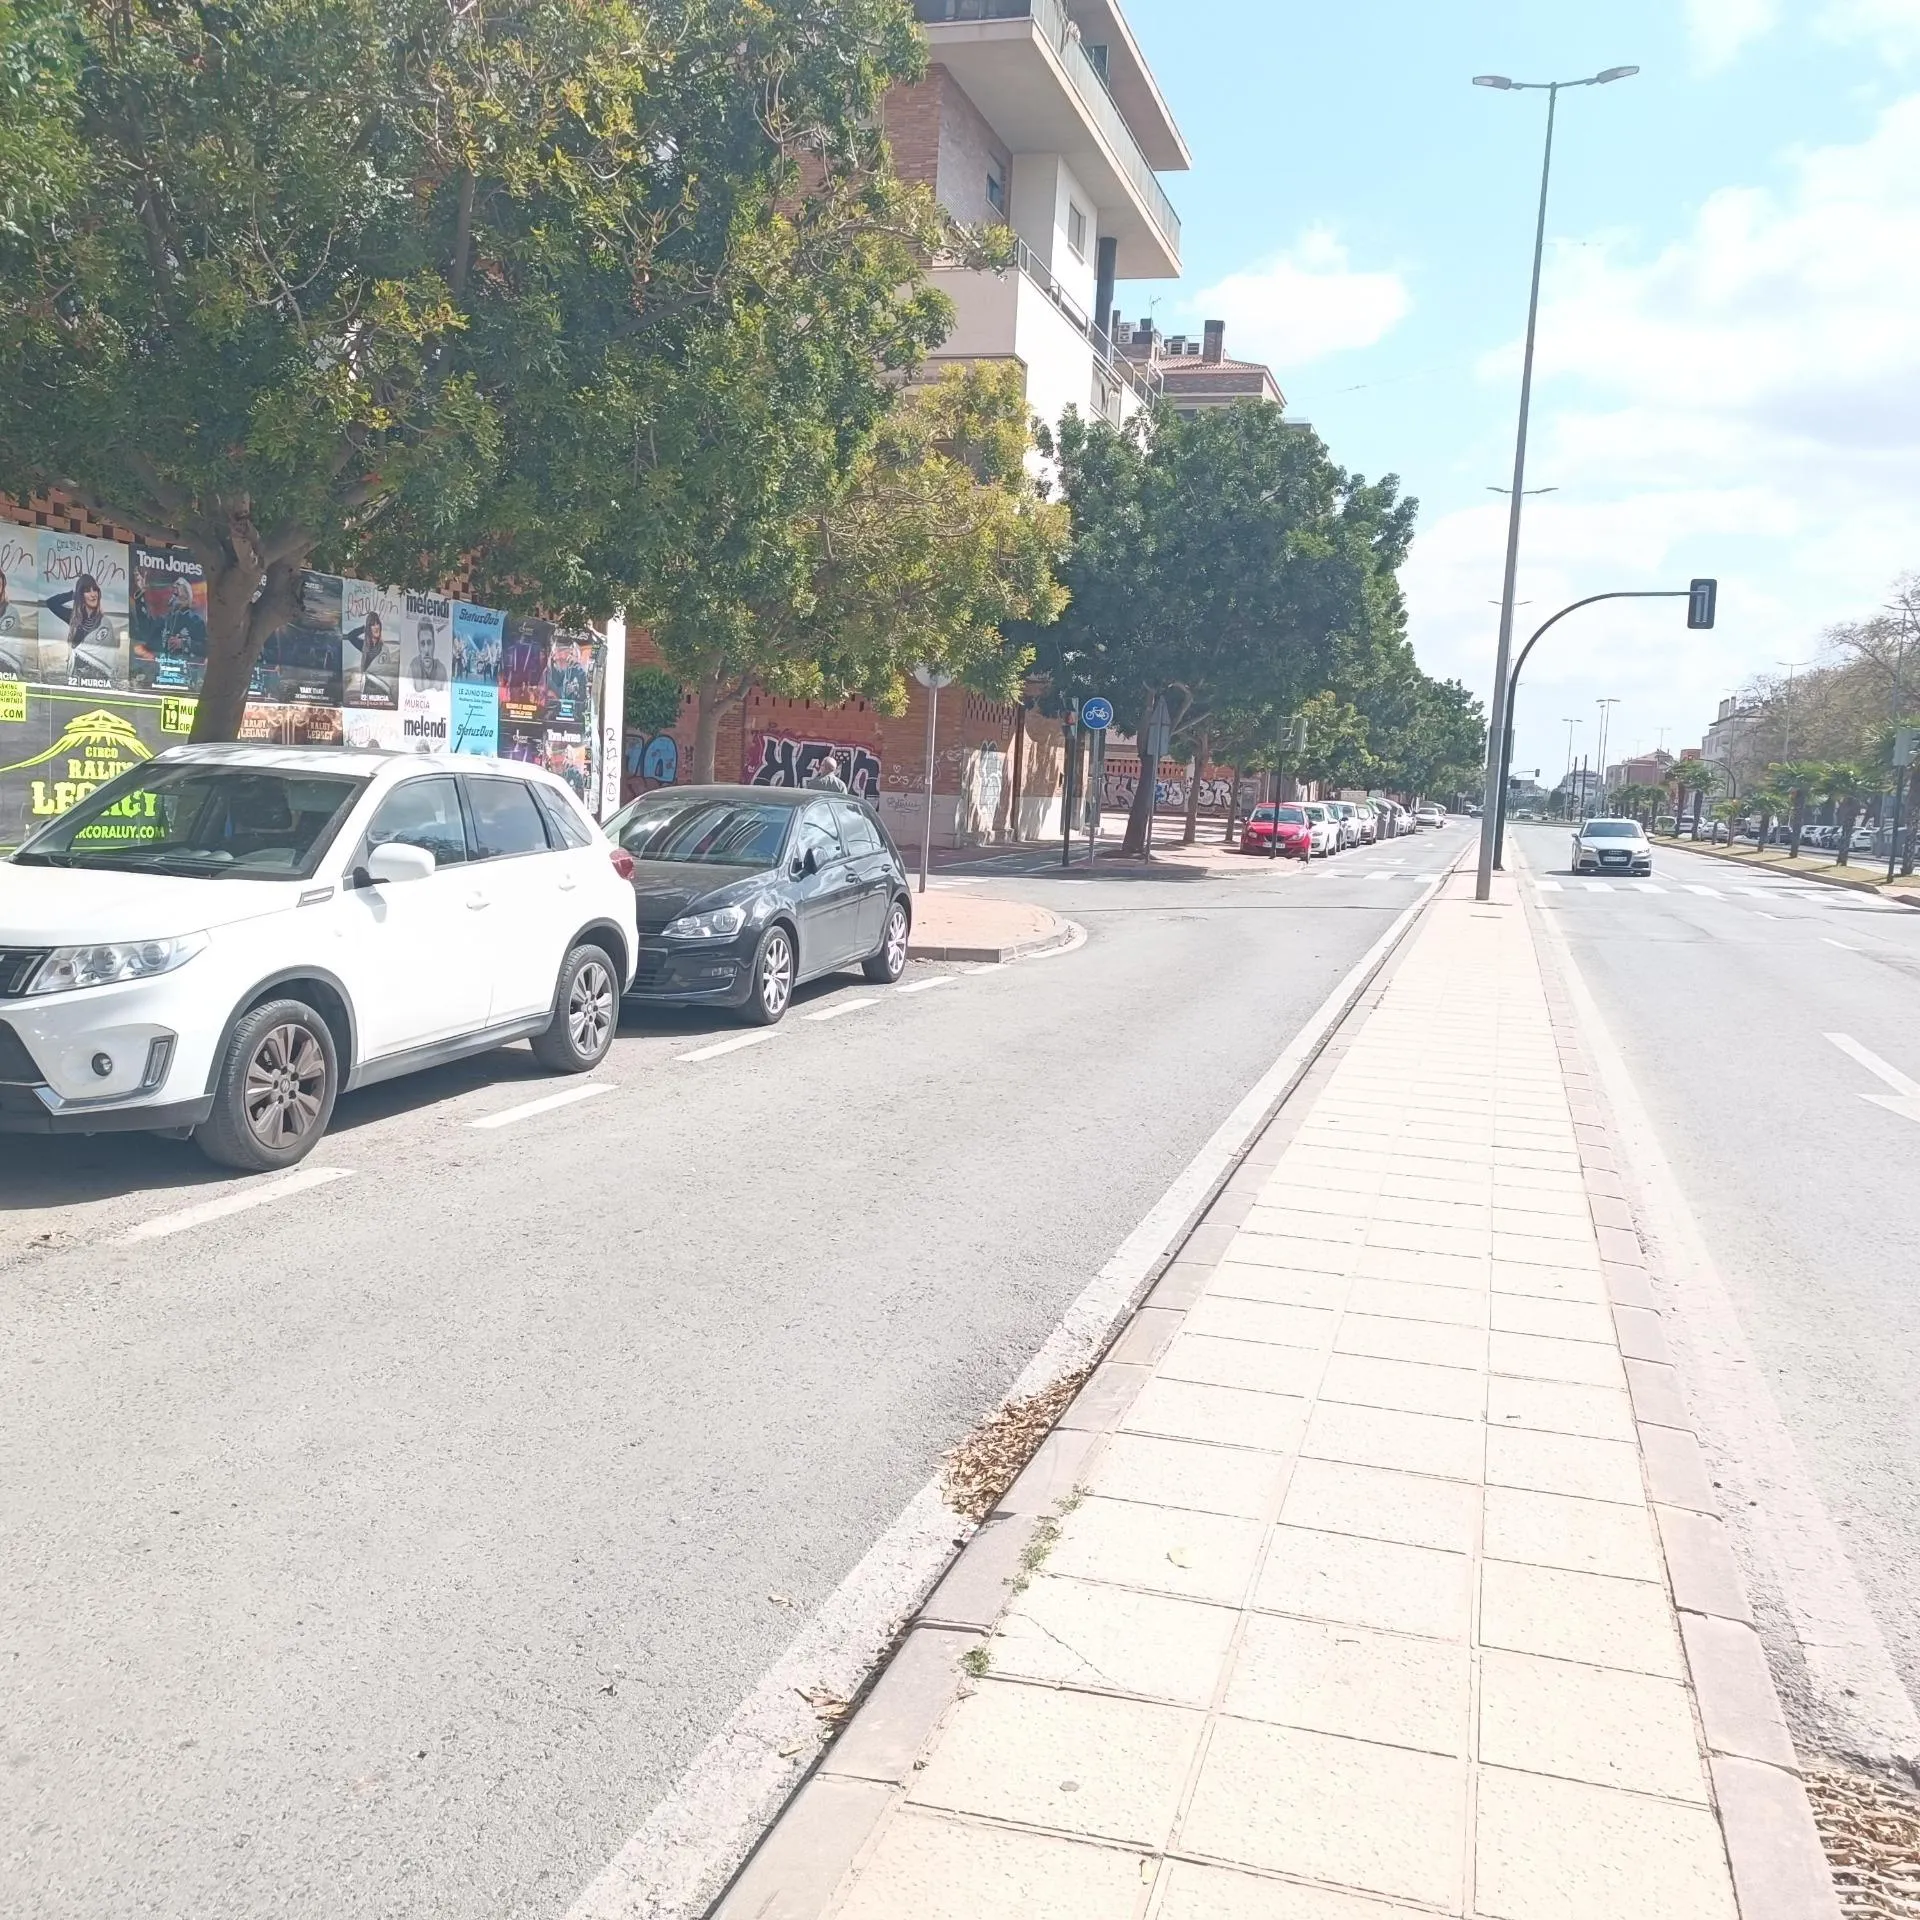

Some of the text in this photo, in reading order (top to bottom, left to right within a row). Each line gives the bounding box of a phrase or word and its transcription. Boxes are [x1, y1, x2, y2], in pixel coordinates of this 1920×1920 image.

[137, 550, 203, 576] Tom Jones
[406, 593, 450, 619] melendi
[68, 677, 112, 688] 22 MURCIA
[404, 698, 430, 709] MURCIA
[403, 716, 447, 738] melendi
[85, 746, 118, 758] CIRCO
